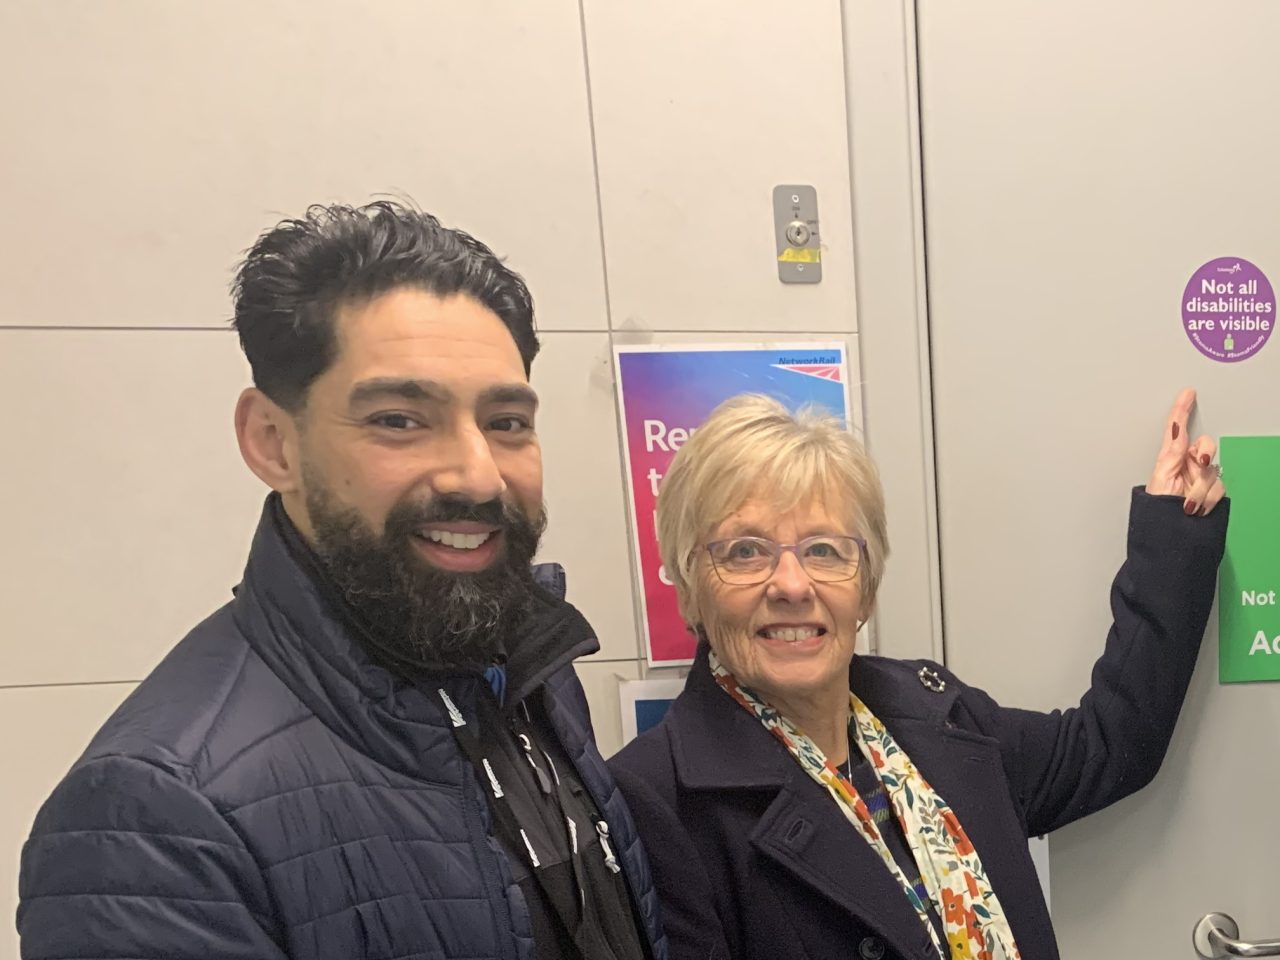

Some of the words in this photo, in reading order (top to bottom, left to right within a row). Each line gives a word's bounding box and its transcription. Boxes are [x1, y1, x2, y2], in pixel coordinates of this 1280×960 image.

[1201, 279, 1234, 294] Not
[1238, 280, 1257, 294] all
[1186, 297, 1272, 313] disabilities
[1188, 319, 1215, 331] are
[1219, 316, 1270, 331] visible
[1241, 590, 1276, 606] Not
